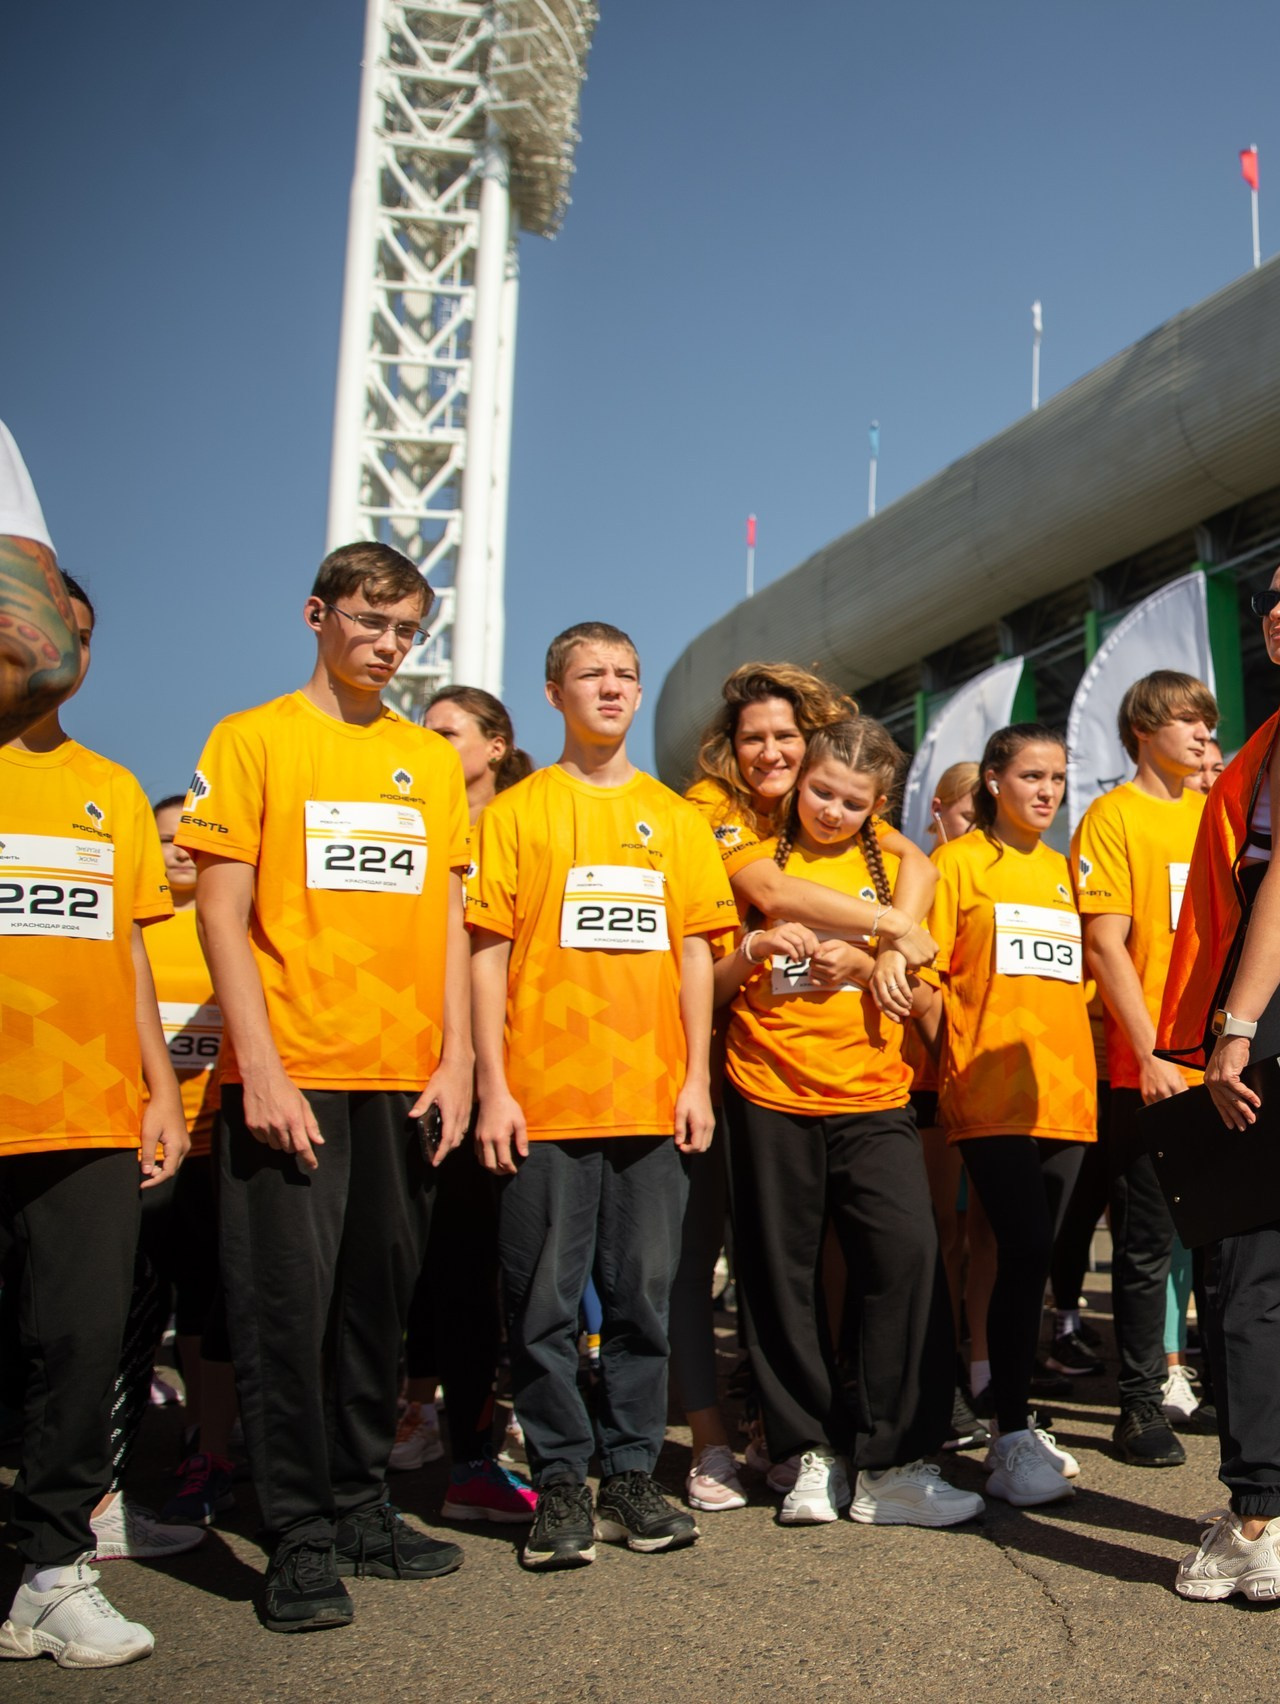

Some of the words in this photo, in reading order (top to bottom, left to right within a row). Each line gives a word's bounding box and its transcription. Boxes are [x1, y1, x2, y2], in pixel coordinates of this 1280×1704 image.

[324, 844, 415, 876] 224
[0, 883, 98, 919] 222
[576, 905, 657, 933] 225
[1009, 938, 1073, 966] 103
